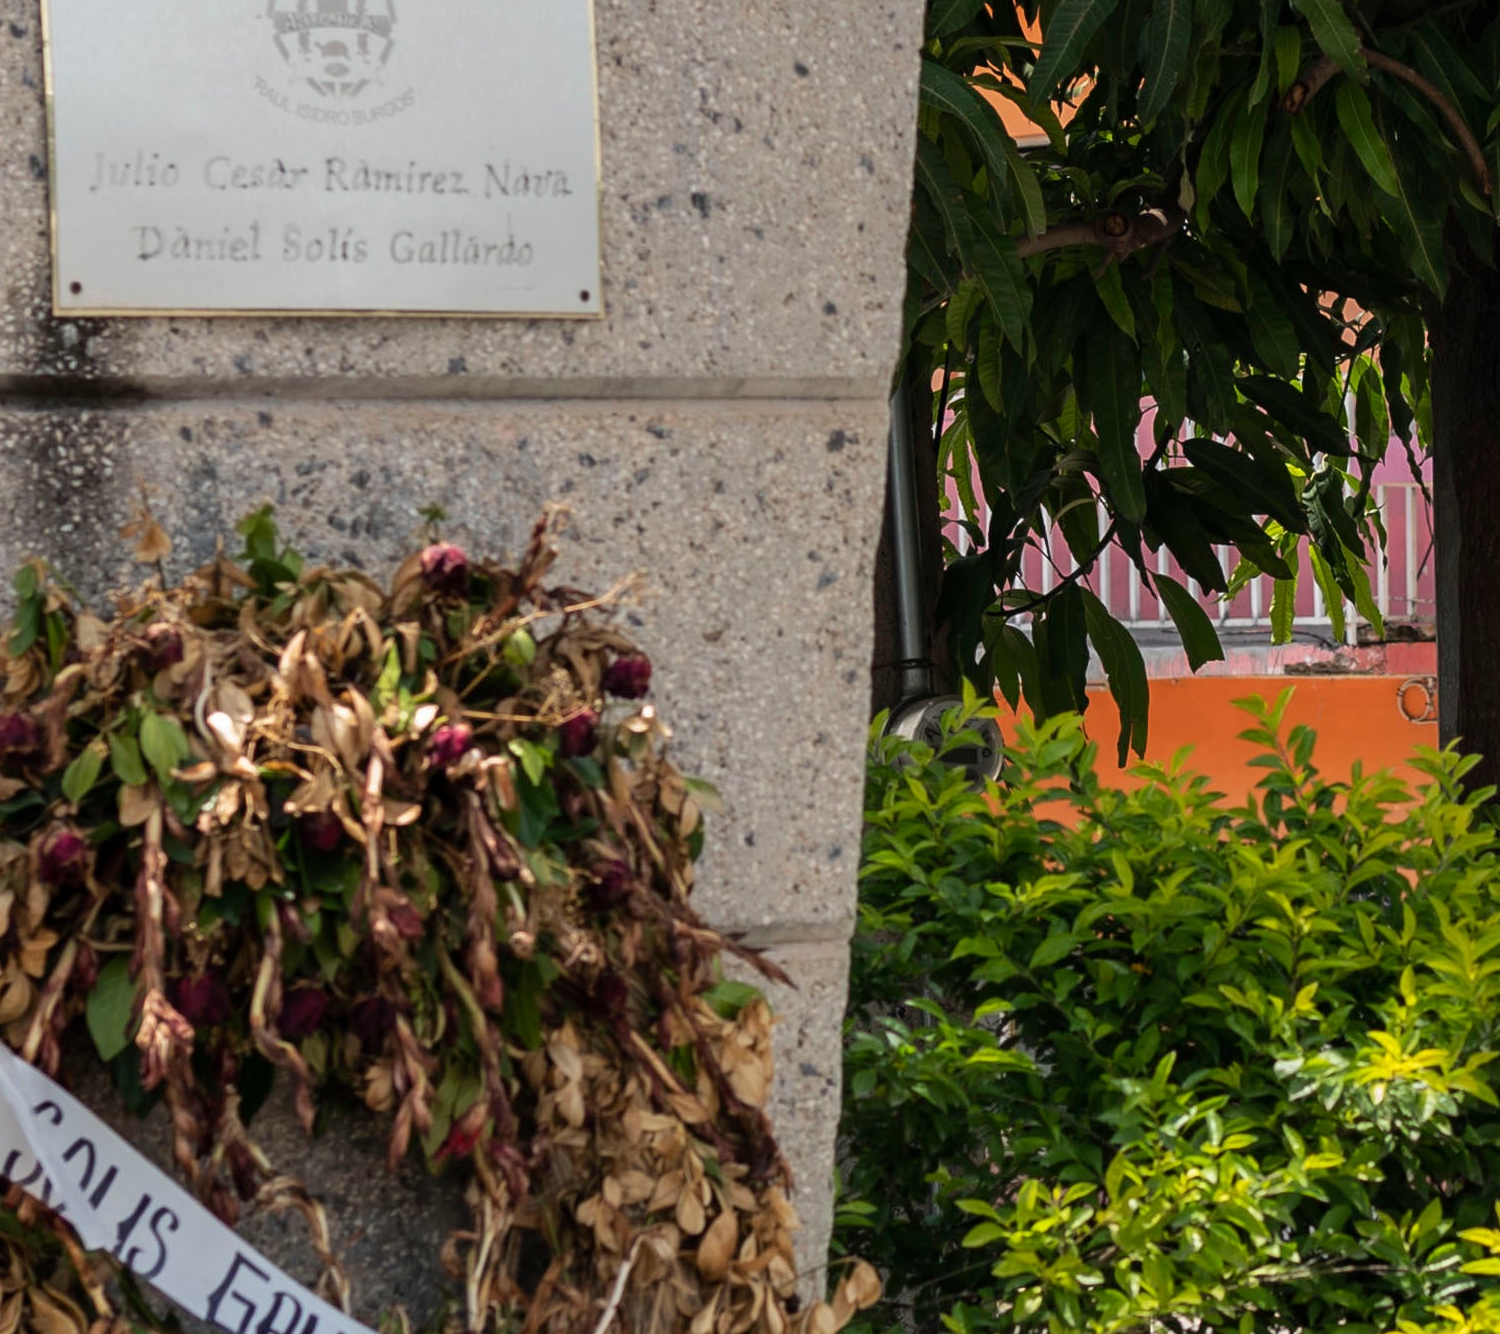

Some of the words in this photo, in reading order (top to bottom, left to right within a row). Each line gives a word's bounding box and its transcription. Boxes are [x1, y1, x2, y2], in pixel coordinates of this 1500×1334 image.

[295, 103, 348, 127] ISIDRO
[89, 151, 180, 192] Julio
[484, 158, 574, 199] Nava
[131, 220, 260, 262] Daniel
[389, 218, 535, 267] Gallardo
